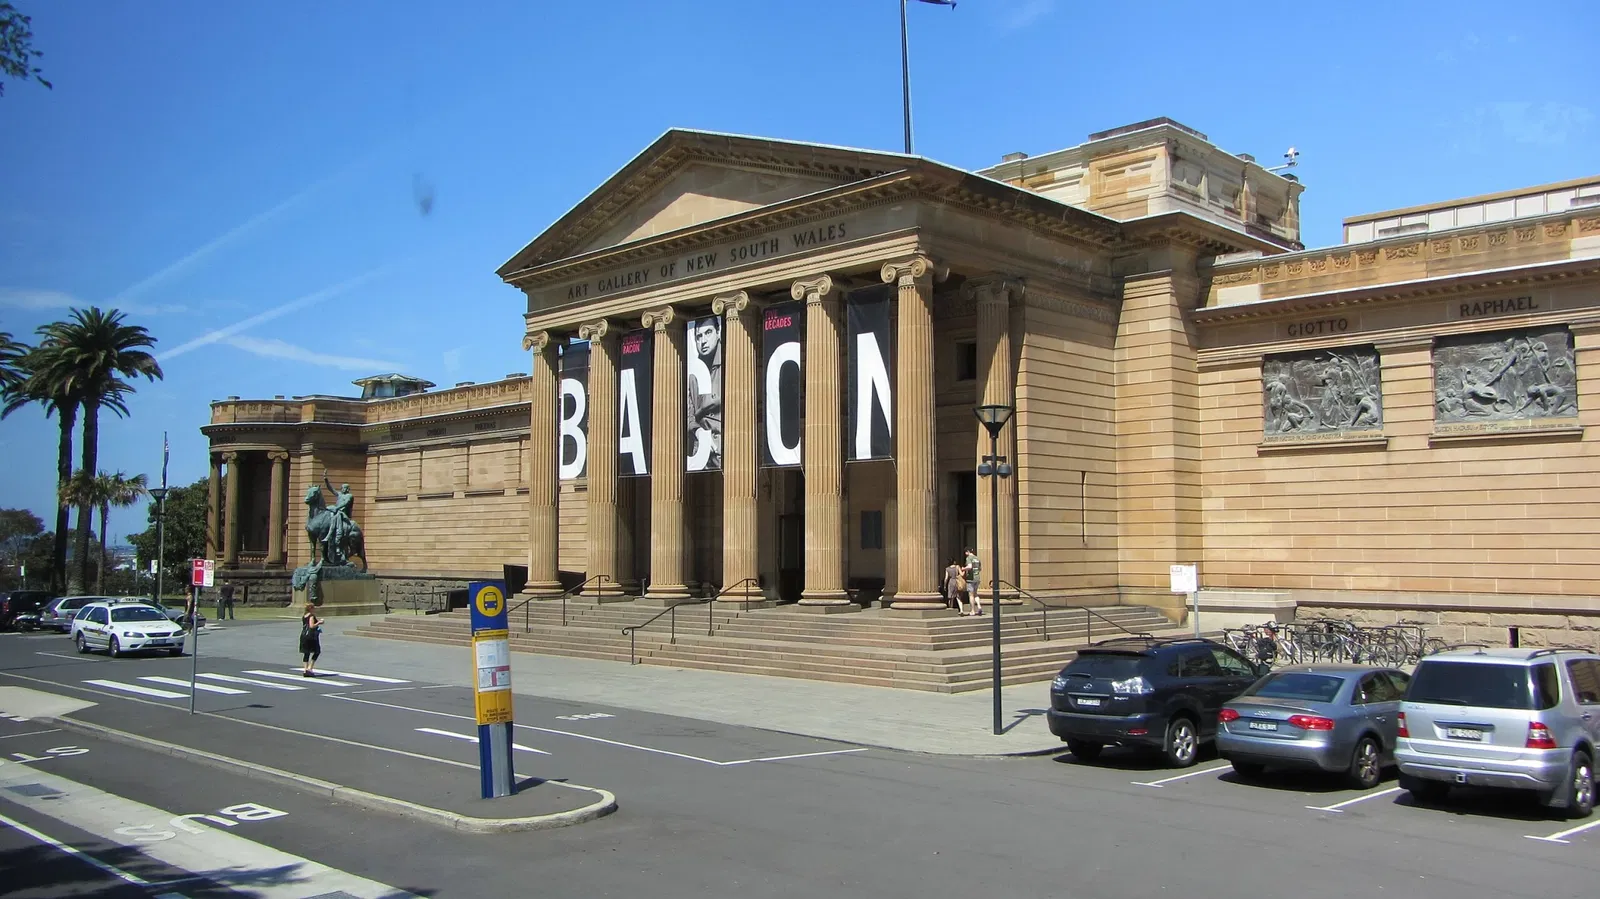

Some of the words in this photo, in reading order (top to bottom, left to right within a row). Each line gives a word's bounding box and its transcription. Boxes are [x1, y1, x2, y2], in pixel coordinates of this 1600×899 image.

[567, 283, 589, 300] ART
[598, 269, 651, 293] GALLERY
[660, 262, 676, 278] OF
[686, 253, 718, 273] NEW
[730, 238, 780, 263] SOUTH
[793, 222, 847, 248] WALES
[1459, 296, 1539, 317] RAPHAEL
[764, 316, 793, 331] DECADES
[1287, 318, 1349, 337] GIOTTO
[622, 343, 641, 354] BACON
[113, 802, 290, 842] BUS
